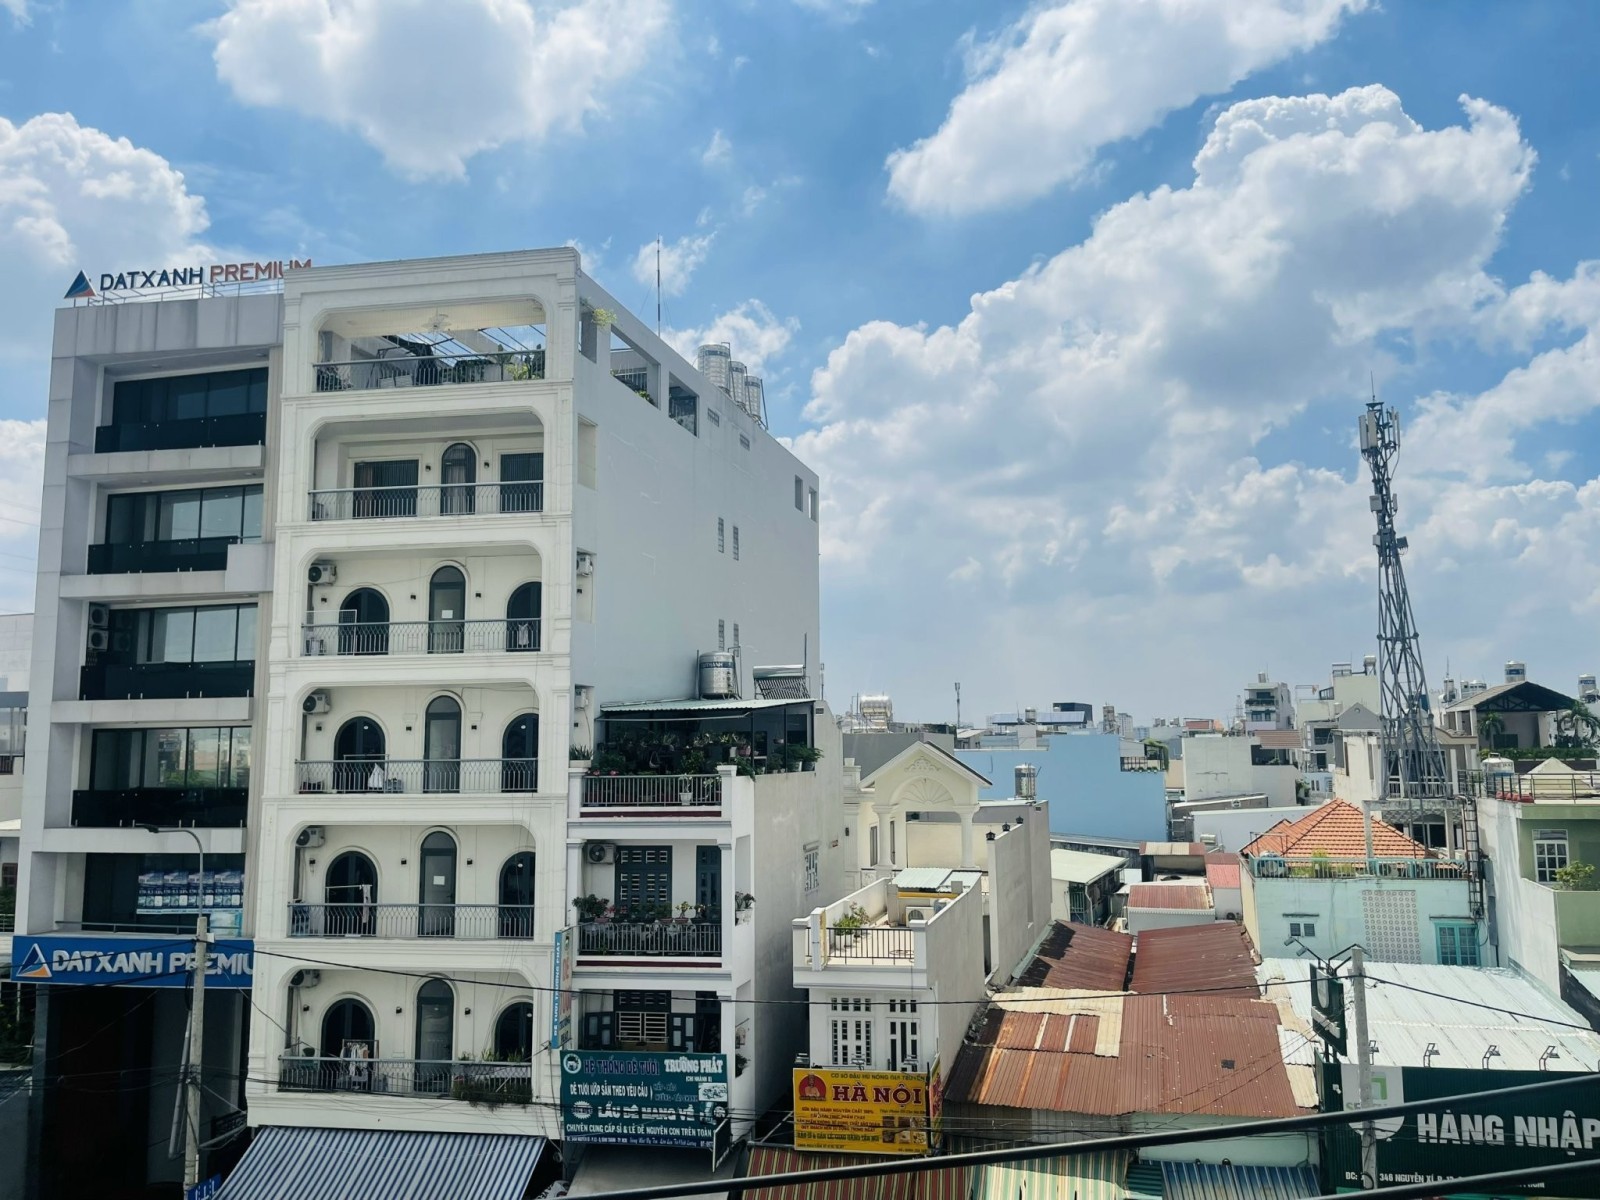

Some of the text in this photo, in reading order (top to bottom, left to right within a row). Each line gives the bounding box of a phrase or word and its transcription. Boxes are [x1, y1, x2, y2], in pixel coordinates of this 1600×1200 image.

[100, 266, 204, 292] DATXANH
[52, 950, 163, 975] DATXANH
[612, 1084, 626, 1096] THEO
[832, 1081, 868, 1102] HÀ
[873, 1082, 922, 1108] NỘI
[566, 1122, 588, 1132] CHUYÊN
[589, 1124, 603, 1133] CUNG
[669, 1128, 680, 1136] CON
[1514, 1110, 1600, 1156] NHẬP
